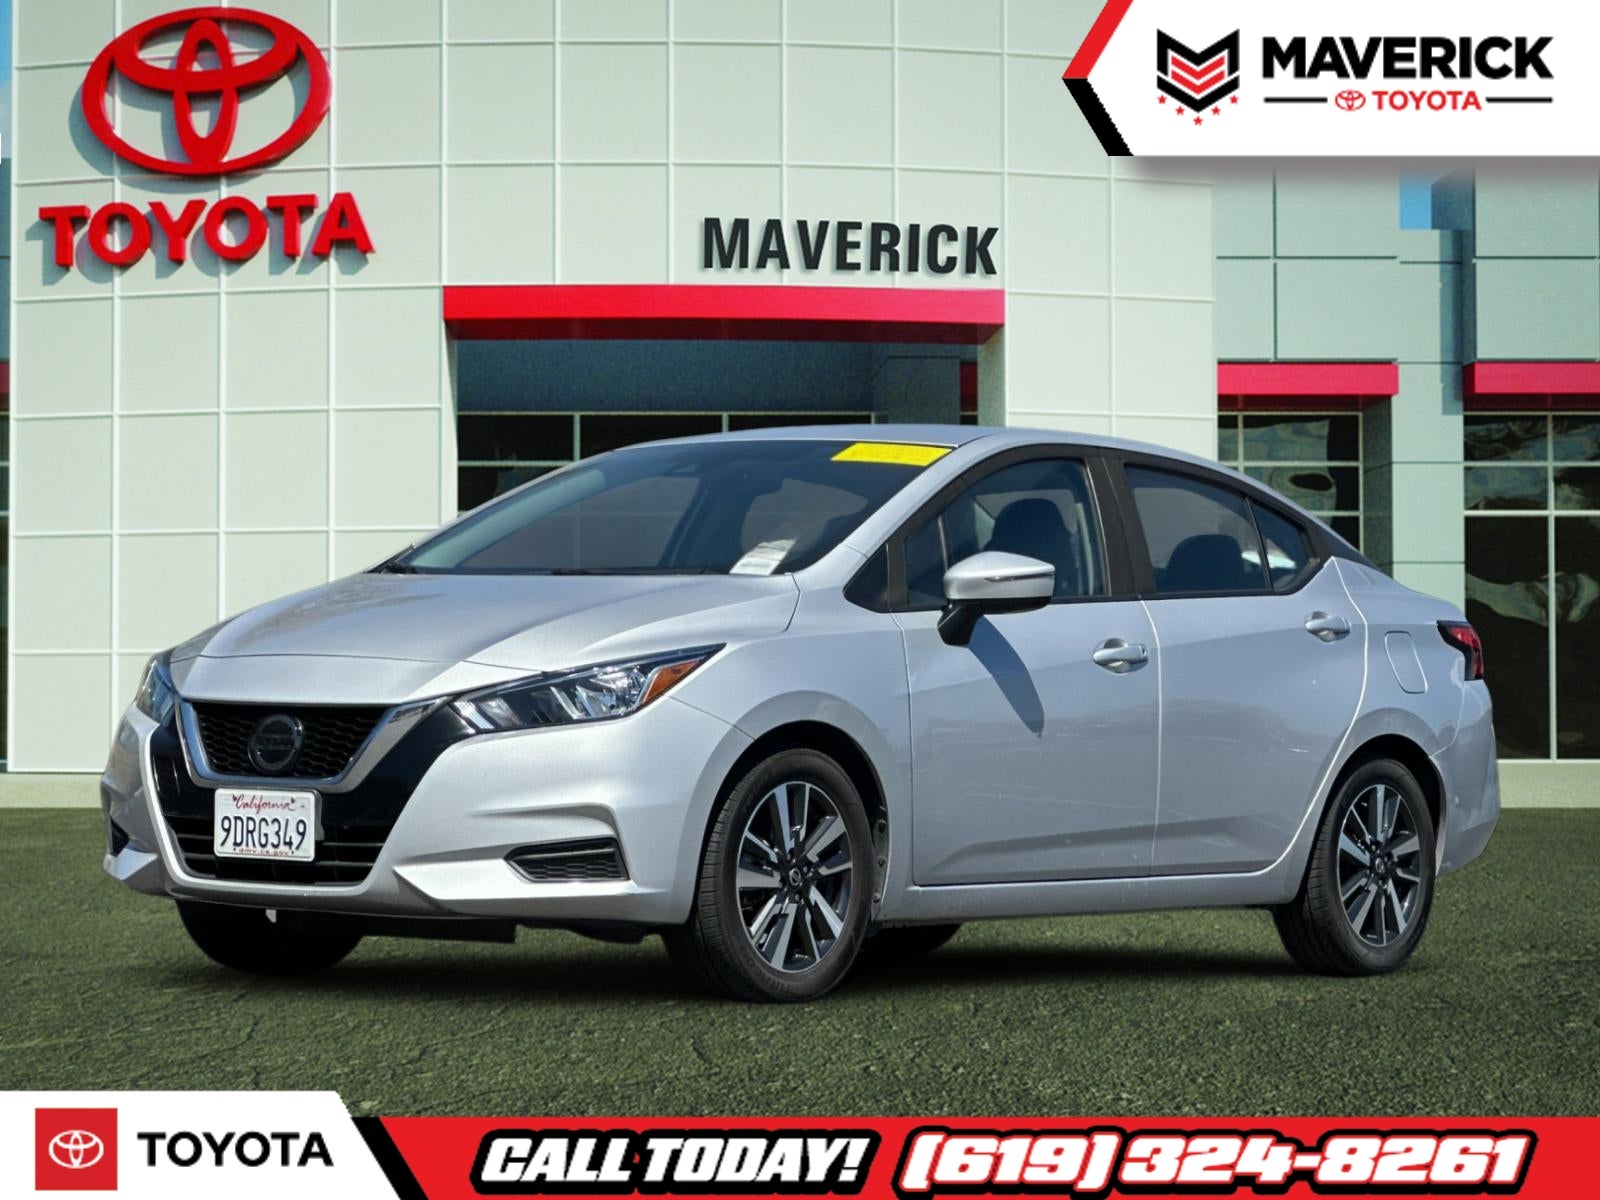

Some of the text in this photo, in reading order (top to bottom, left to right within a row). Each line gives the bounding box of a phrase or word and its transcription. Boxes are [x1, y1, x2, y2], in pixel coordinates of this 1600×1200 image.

[38, 192, 375, 268] TOYOTA
[703, 217, 999, 275] MAVERICK
[235, 794, 296, 814] California
[220, 815, 307, 851] 9DRG349
